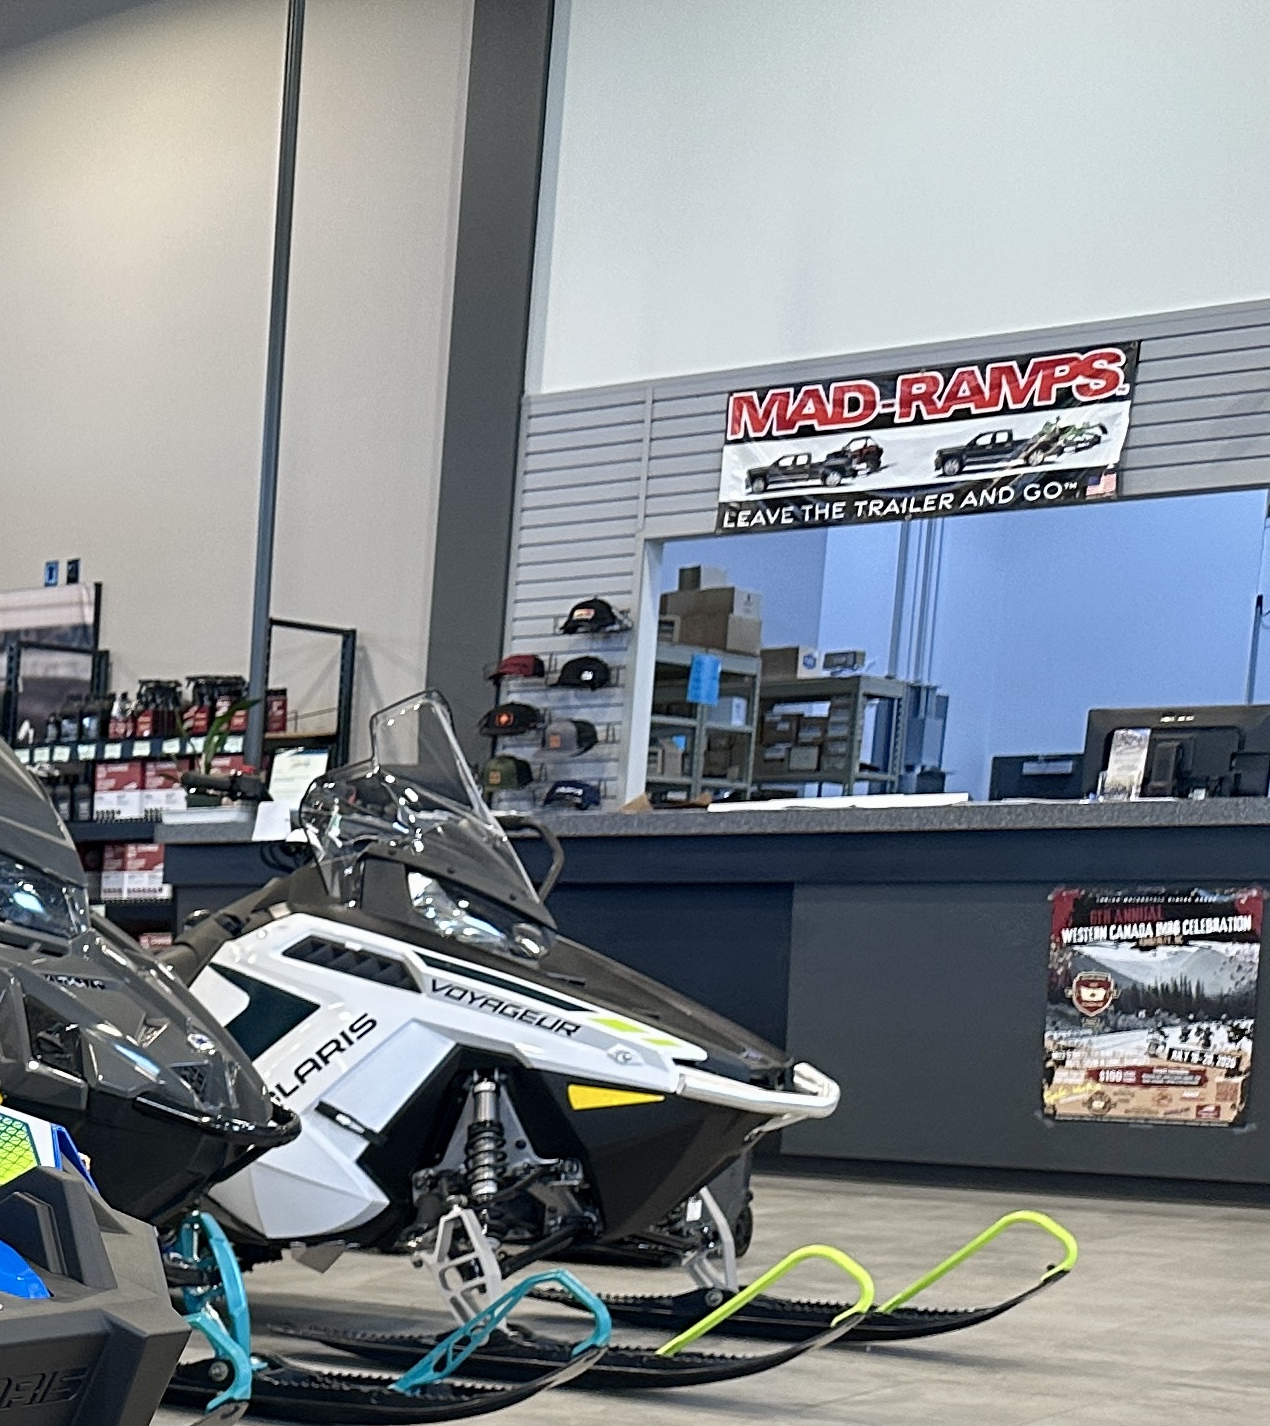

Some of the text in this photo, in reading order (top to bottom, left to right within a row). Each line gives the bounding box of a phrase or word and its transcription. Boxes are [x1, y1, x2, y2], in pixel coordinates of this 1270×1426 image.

[727, 348, 1126, 440] MAD-RAMPS
[722, 506, 794, 529] LEAVE
[803, 501, 846, 520] THE
[853, 493, 955, 519] TRAILER
[960, 486, 1016, 508] AND
[1061, 926, 1108, 944] WESTERN
[1109, 922, 1154, 940] CANADA
[1182, 914, 1252, 936] CELEBRATION
[431, 978, 581, 1038] VOYAGEUR
